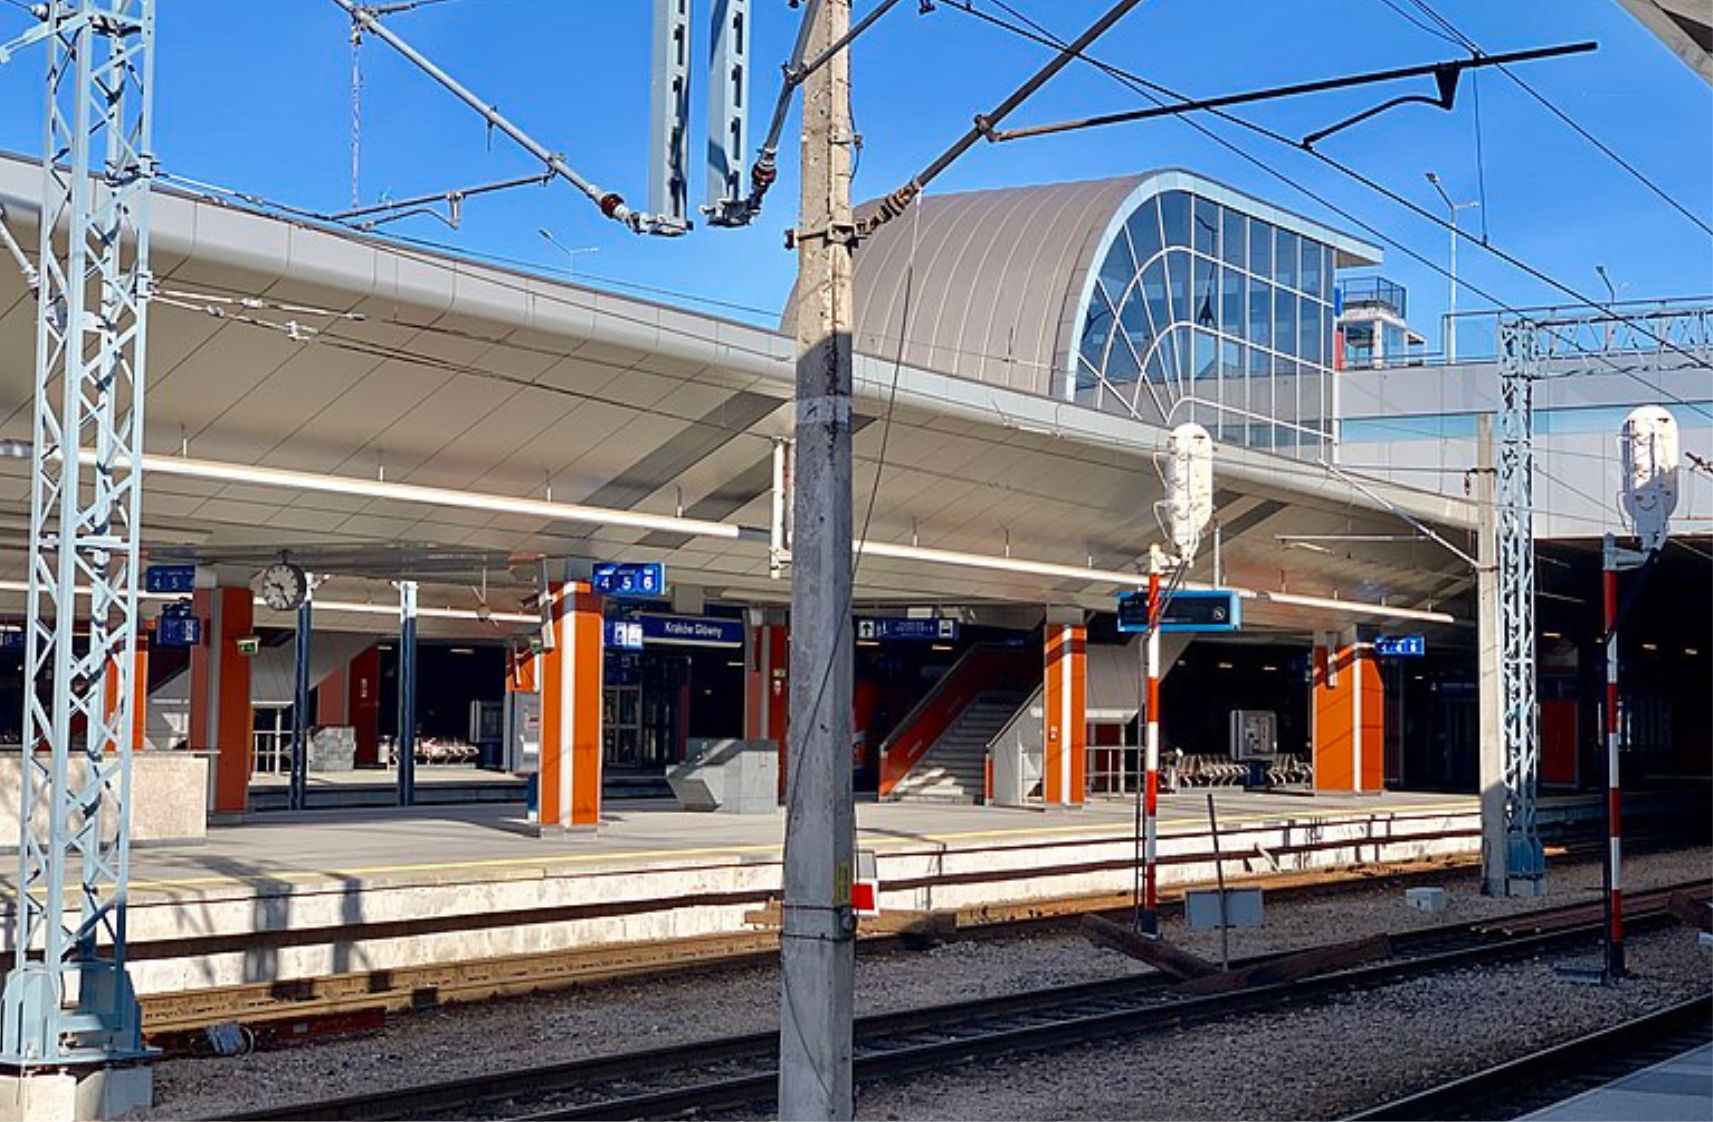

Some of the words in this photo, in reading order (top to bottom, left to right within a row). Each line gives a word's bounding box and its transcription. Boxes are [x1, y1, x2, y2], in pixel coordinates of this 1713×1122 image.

[601, 577, 610, 589] 4
[622, 576, 631, 590] 5
[643, 576, 653, 590] 6
[664, 622, 693, 634] Kraków
[695, 624, 722, 639] Główny
